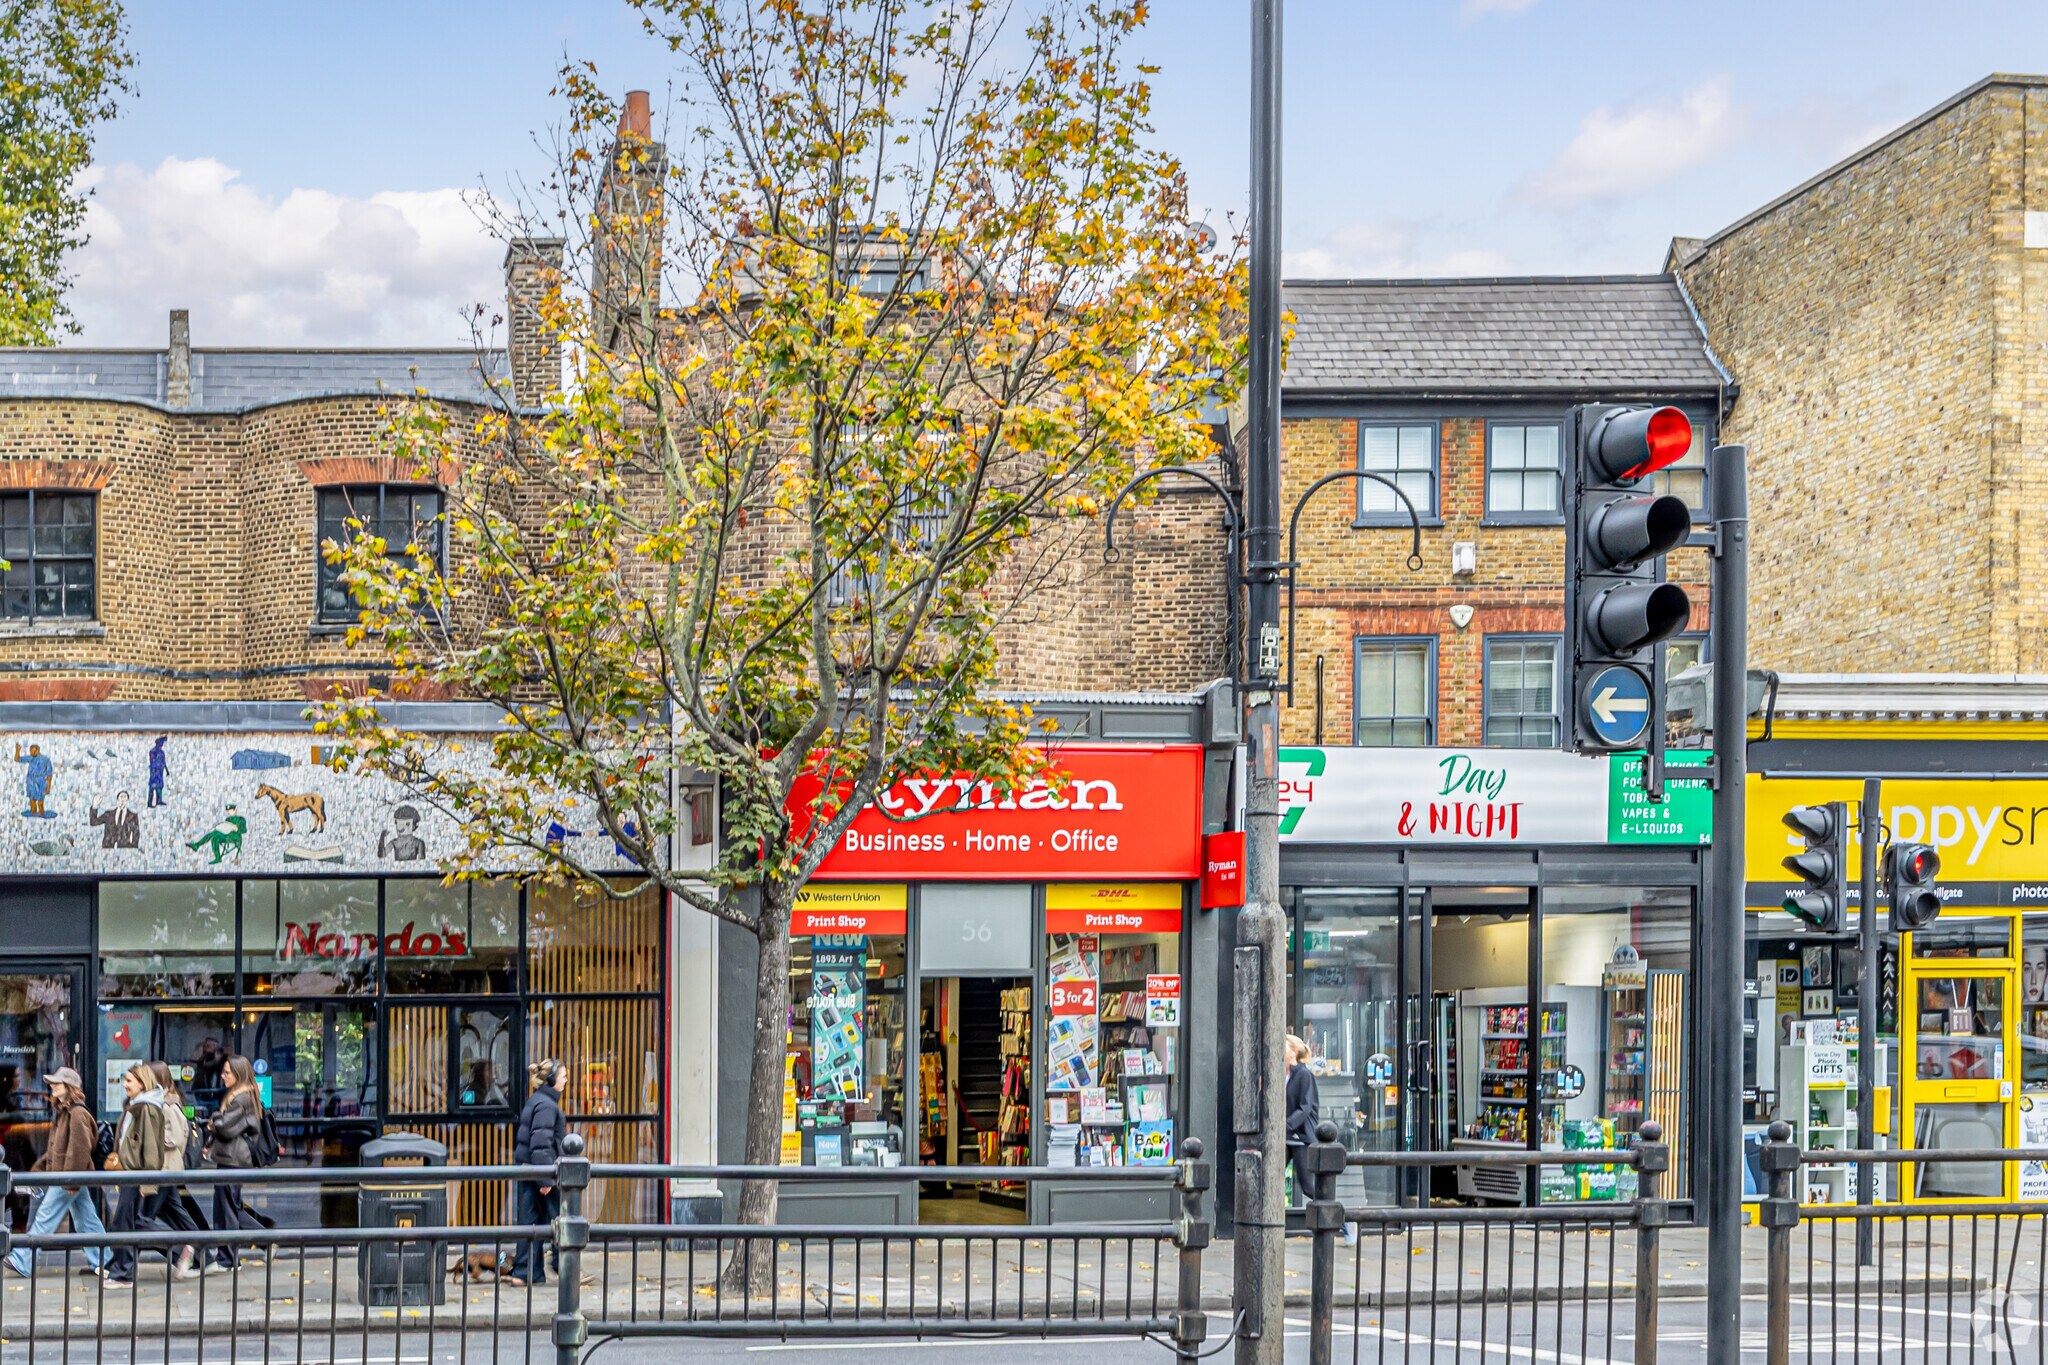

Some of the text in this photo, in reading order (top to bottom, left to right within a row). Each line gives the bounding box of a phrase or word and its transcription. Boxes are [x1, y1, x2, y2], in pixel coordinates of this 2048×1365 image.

[1438, 754, 1507, 800] Day
[1622, 808, 1670, 818] VAPES &
[1398, 801, 1525, 839] & NIGHT
[1621, 823, 1683, 835] E-LIQUIDS
[845, 829, 1119, 852] Business Home Office
[1699, 834, 1711, 843] 54
[1208, 860, 1237, 873] Ryman
[813, 892, 881, 902] Western Union
[1097, 888, 1131, 898] DHL
[807, 915, 866, 929] Print Shop
[1085, 914, 1143, 928] Print Shop
[961, 920, 992, 942] 56
[281, 921, 466, 958] Nando's
[814, 934, 865, 947] New
[815, 955, 854, 964] 1893 Art
[1148, 979, 1165, 988] 20%
[1053, 987, 1095, 1007] 3 for 2
[3, 1045, 36, 1054] Nando's
[1812, 1064, 1843, 1074] GIFTS
